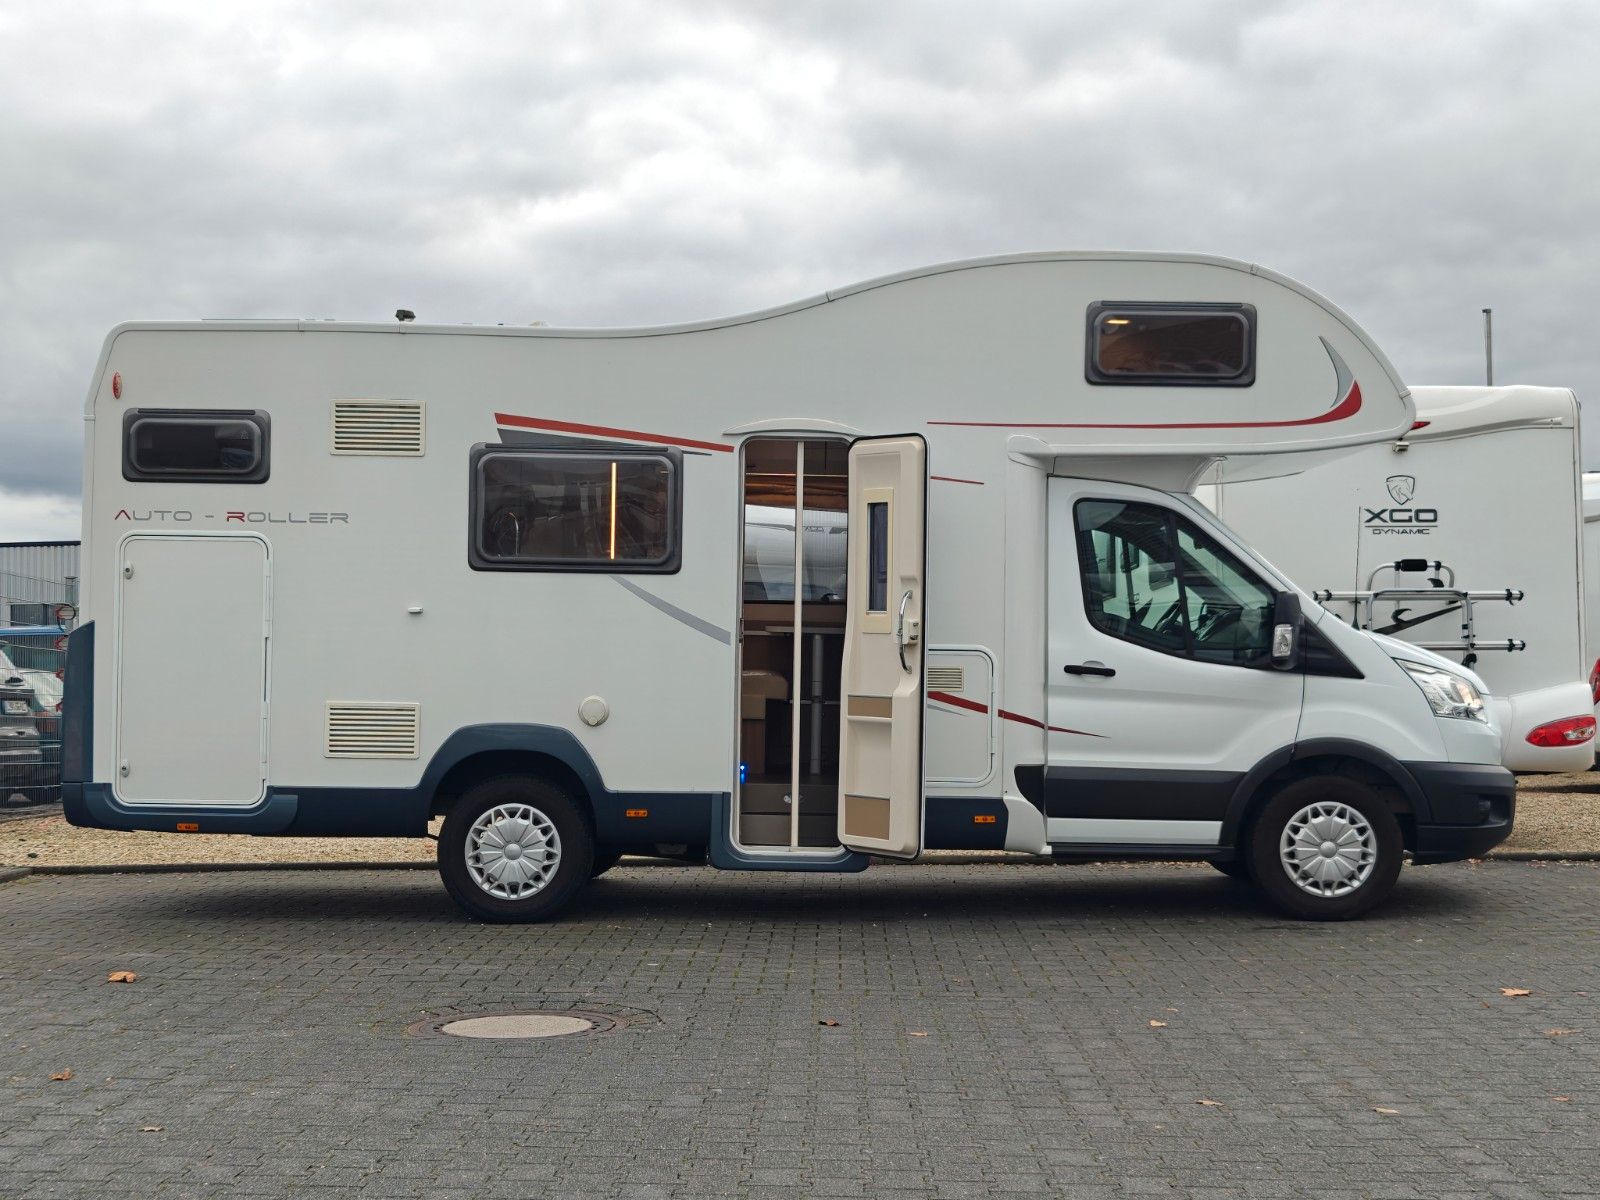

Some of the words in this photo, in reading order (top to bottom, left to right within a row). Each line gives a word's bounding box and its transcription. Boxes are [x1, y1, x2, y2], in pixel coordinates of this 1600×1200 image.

[114, 509, 193, 522] AUTO
[226, 511, 350, 524] ROLLER
[1363, 508, 1438, 524] XGO
